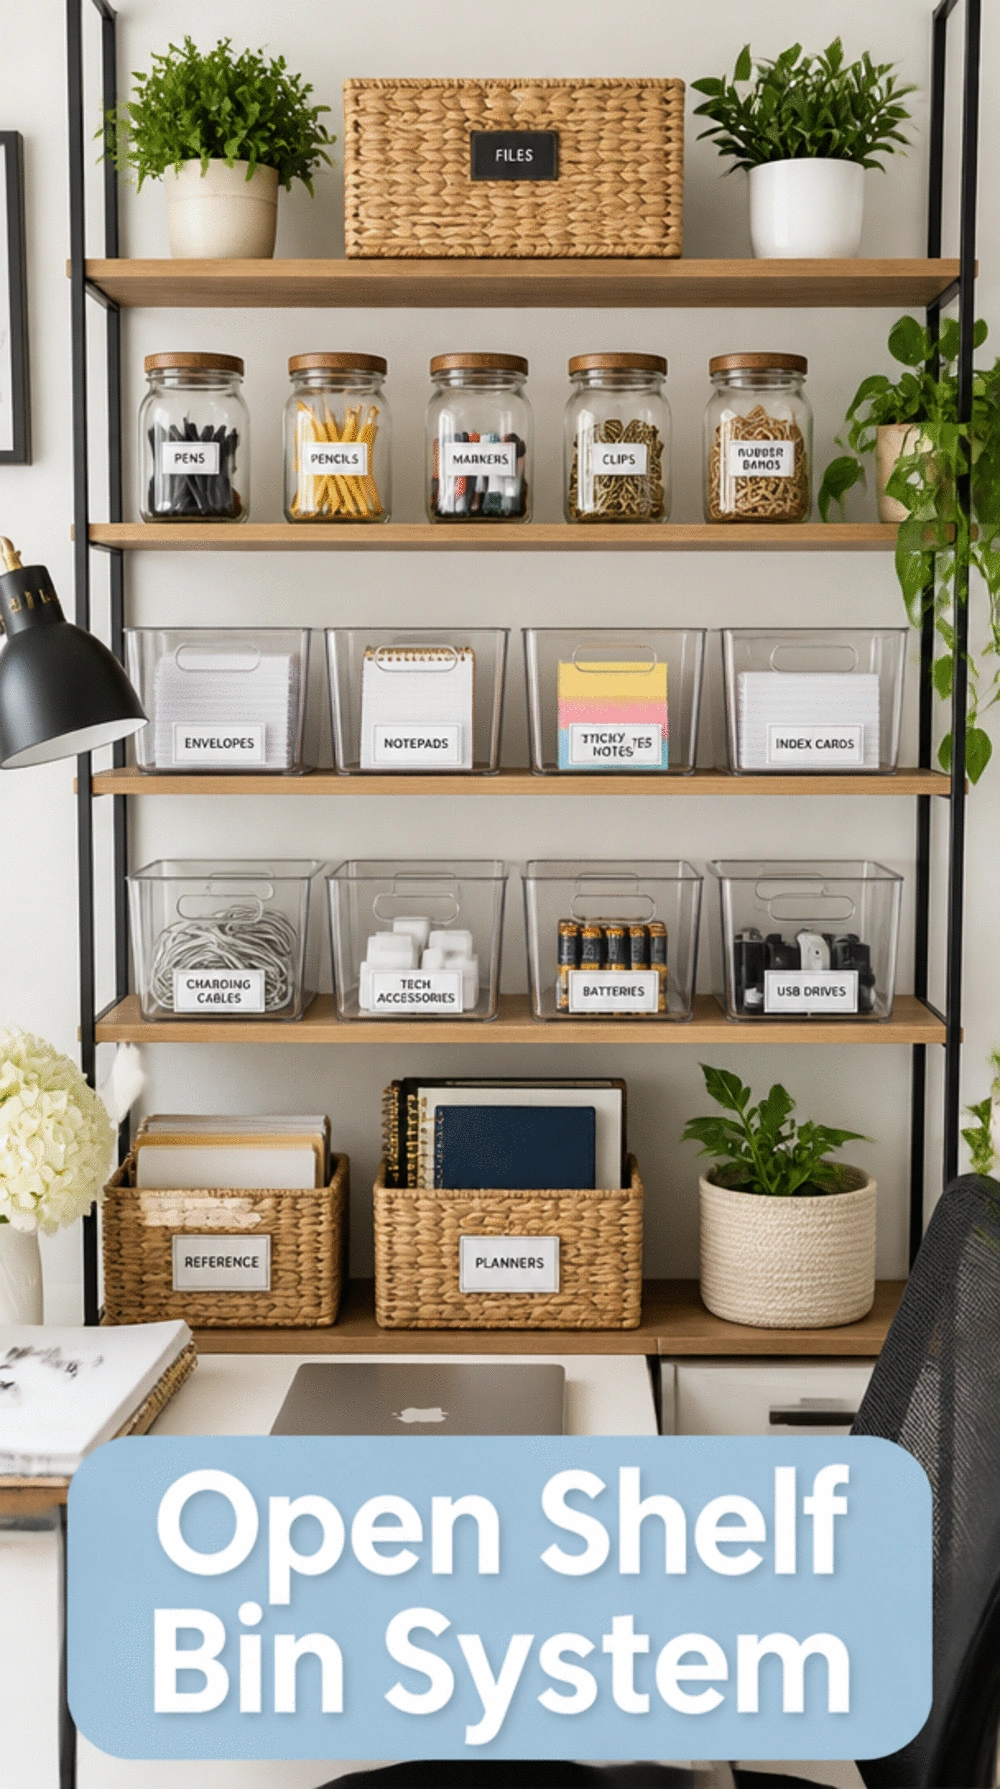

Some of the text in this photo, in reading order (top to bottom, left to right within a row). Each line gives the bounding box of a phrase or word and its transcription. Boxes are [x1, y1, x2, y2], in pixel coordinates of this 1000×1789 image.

[495, 149, 533, 162] FILES
[174, 453, 205, 464] PENS
[311, 453, 359, 465] PENCILS
[452, 454, 509, 465] MARKERS
[602, 454, 636, 466] CLIPS
[185, 738, 254, 749] ENVELOPES
[384, 738, 449, 749] NOTEPADS
[776, 738, 855, 750] INDEX CARDS
[593, 746, 634, 757] NOTES
[400, 979, 431, 990] TECH
[583, 986, 645, 997] BATTERIES
[777, 986, 846, 997] USB DRIVES
[197, 993, 242, 1004] CABLES
[376, 993, 455, 1004] ACCESSORIES
[184, 1256, 259, 1269] REFERENCE
[475, 1257, 545, 1270] PLANNERS
